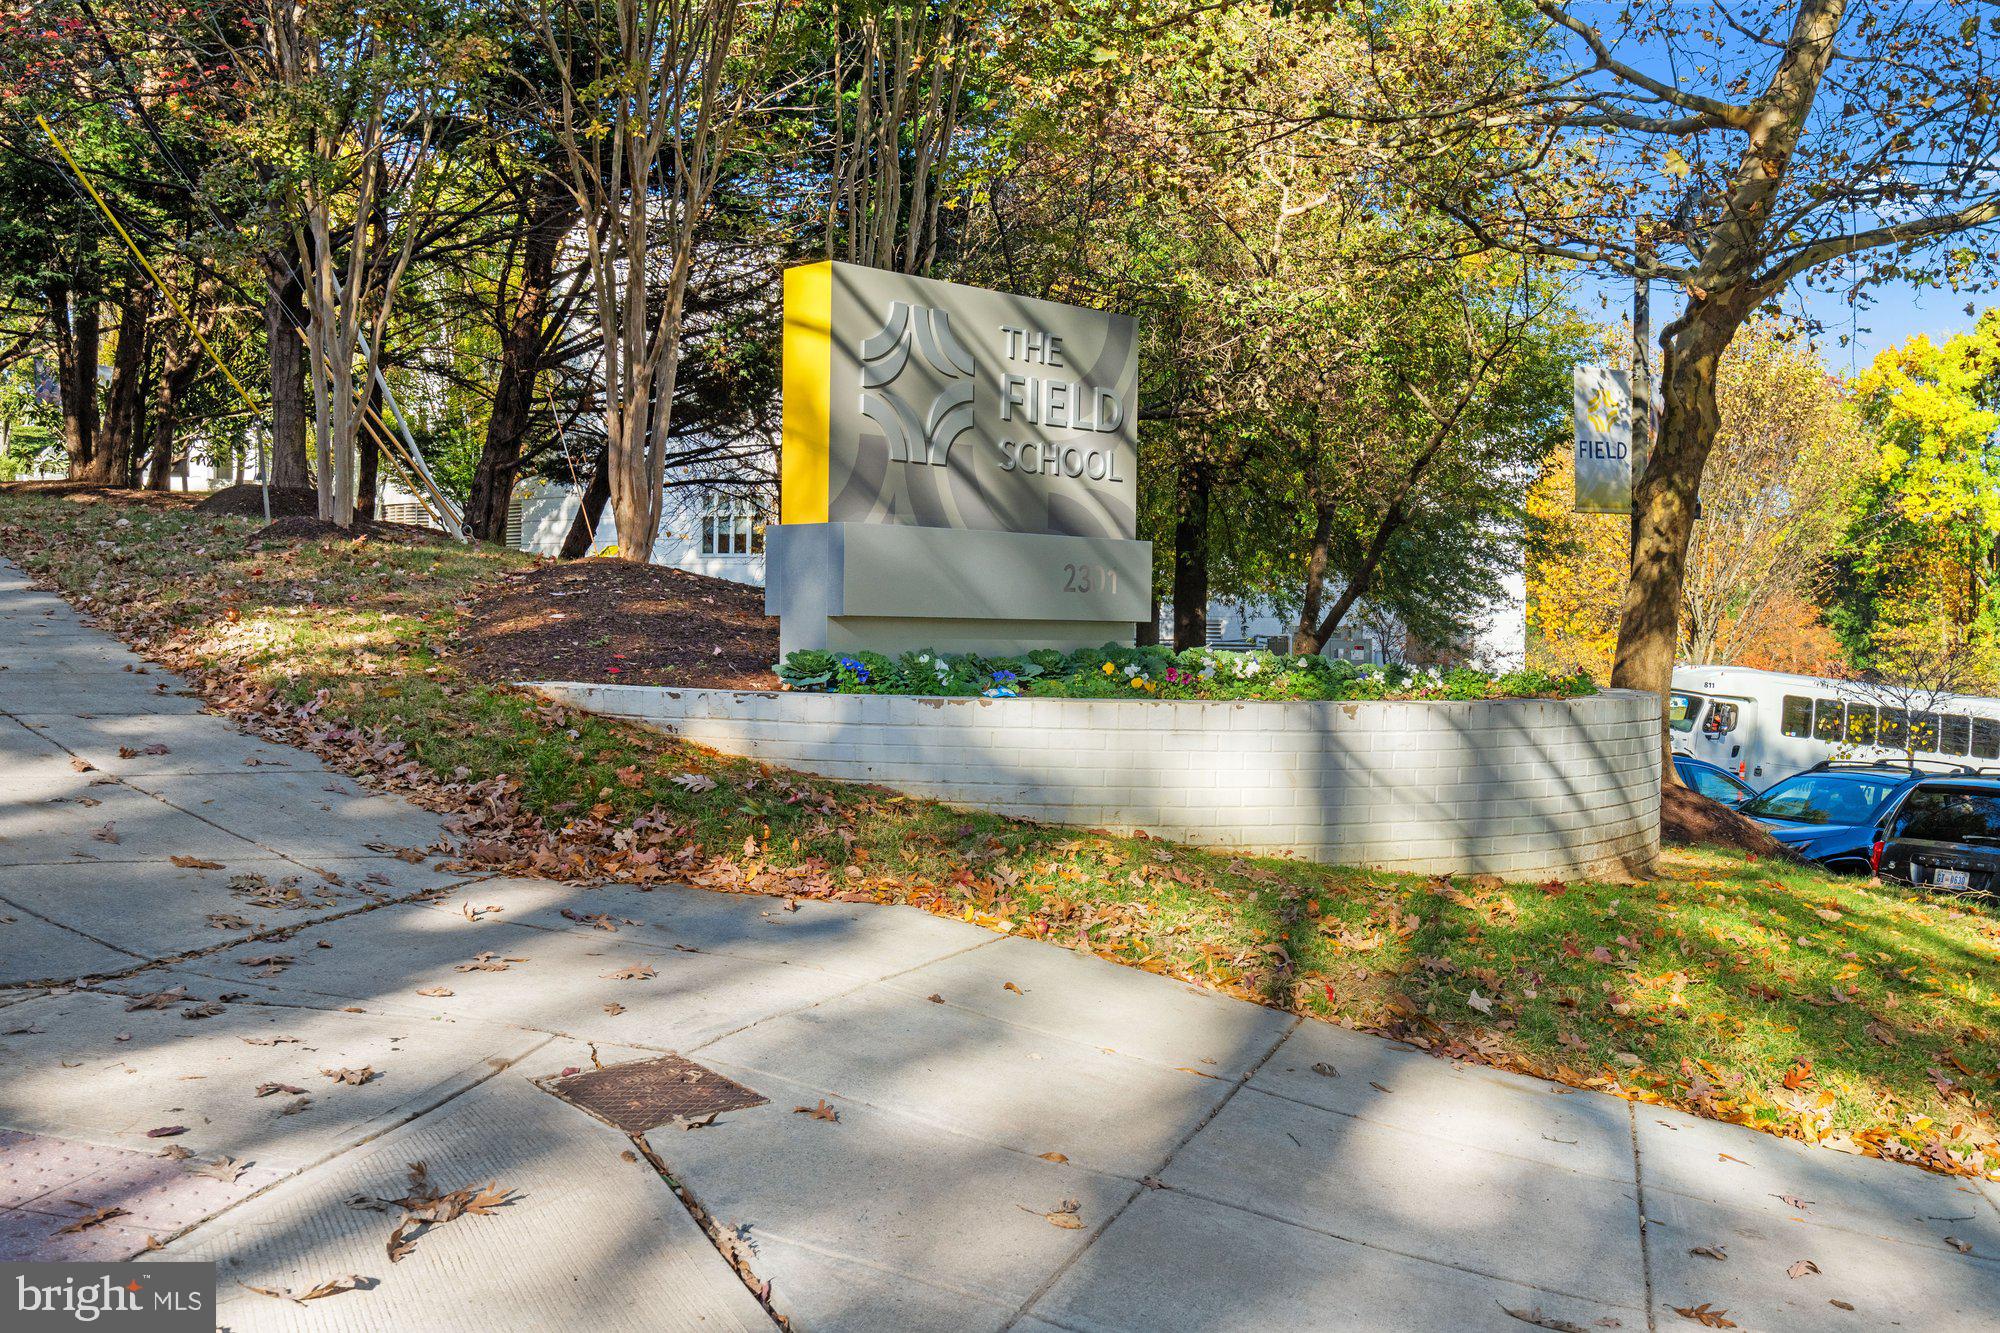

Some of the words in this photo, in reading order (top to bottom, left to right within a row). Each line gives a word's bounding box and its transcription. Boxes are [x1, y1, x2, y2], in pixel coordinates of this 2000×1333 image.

[999, 325, 1063, 367] THE
[1000, 373, 1124, 433] FIELD
[998, 438, 1123, 483] SCHOOL
[1579, 440, 1628, 460] FIELD
[1063, 563, 1117, 594] 2301
